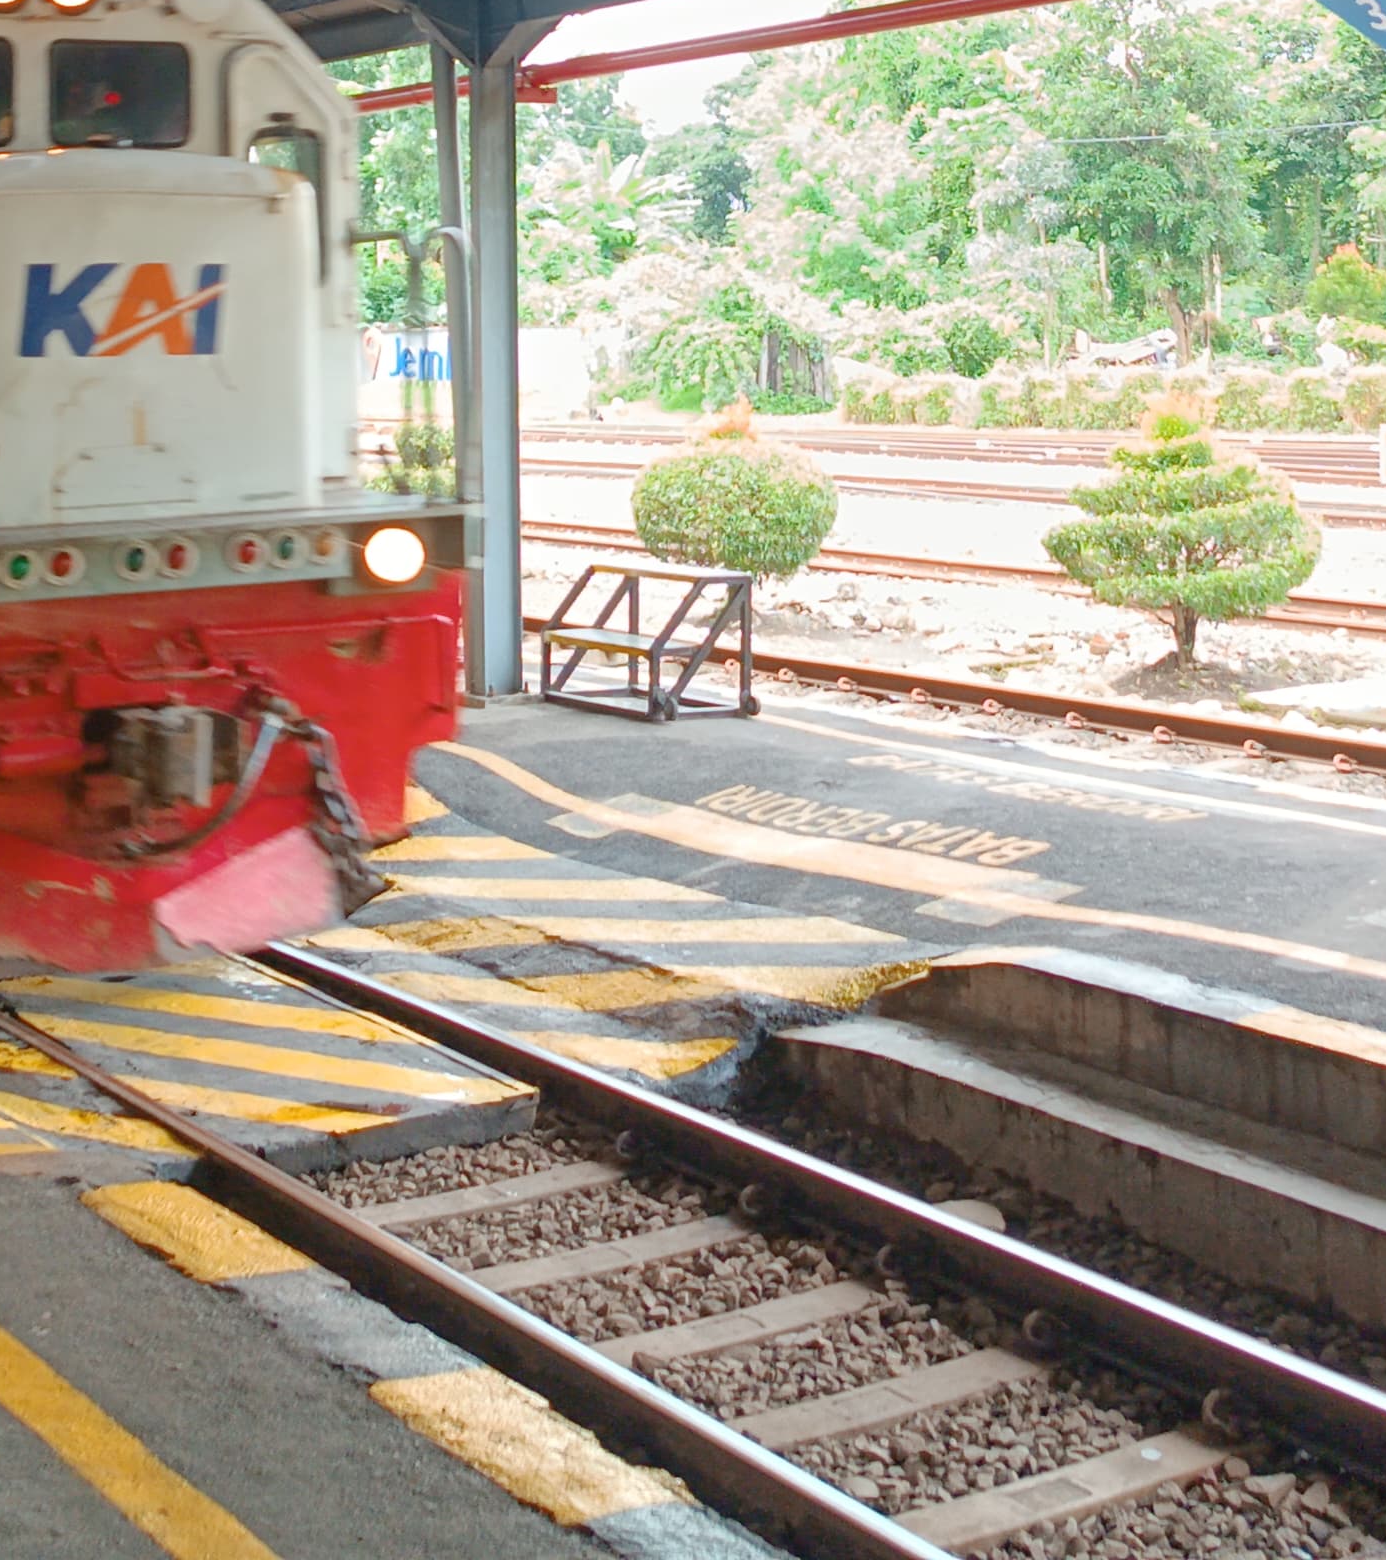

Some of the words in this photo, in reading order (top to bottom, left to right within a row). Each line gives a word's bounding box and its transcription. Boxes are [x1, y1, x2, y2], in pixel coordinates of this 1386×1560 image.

[19, 262, 226, 358] KAI
[694, 783, 892, 838] BERDIRI
[865, 819, 1051, 867] BATAS
